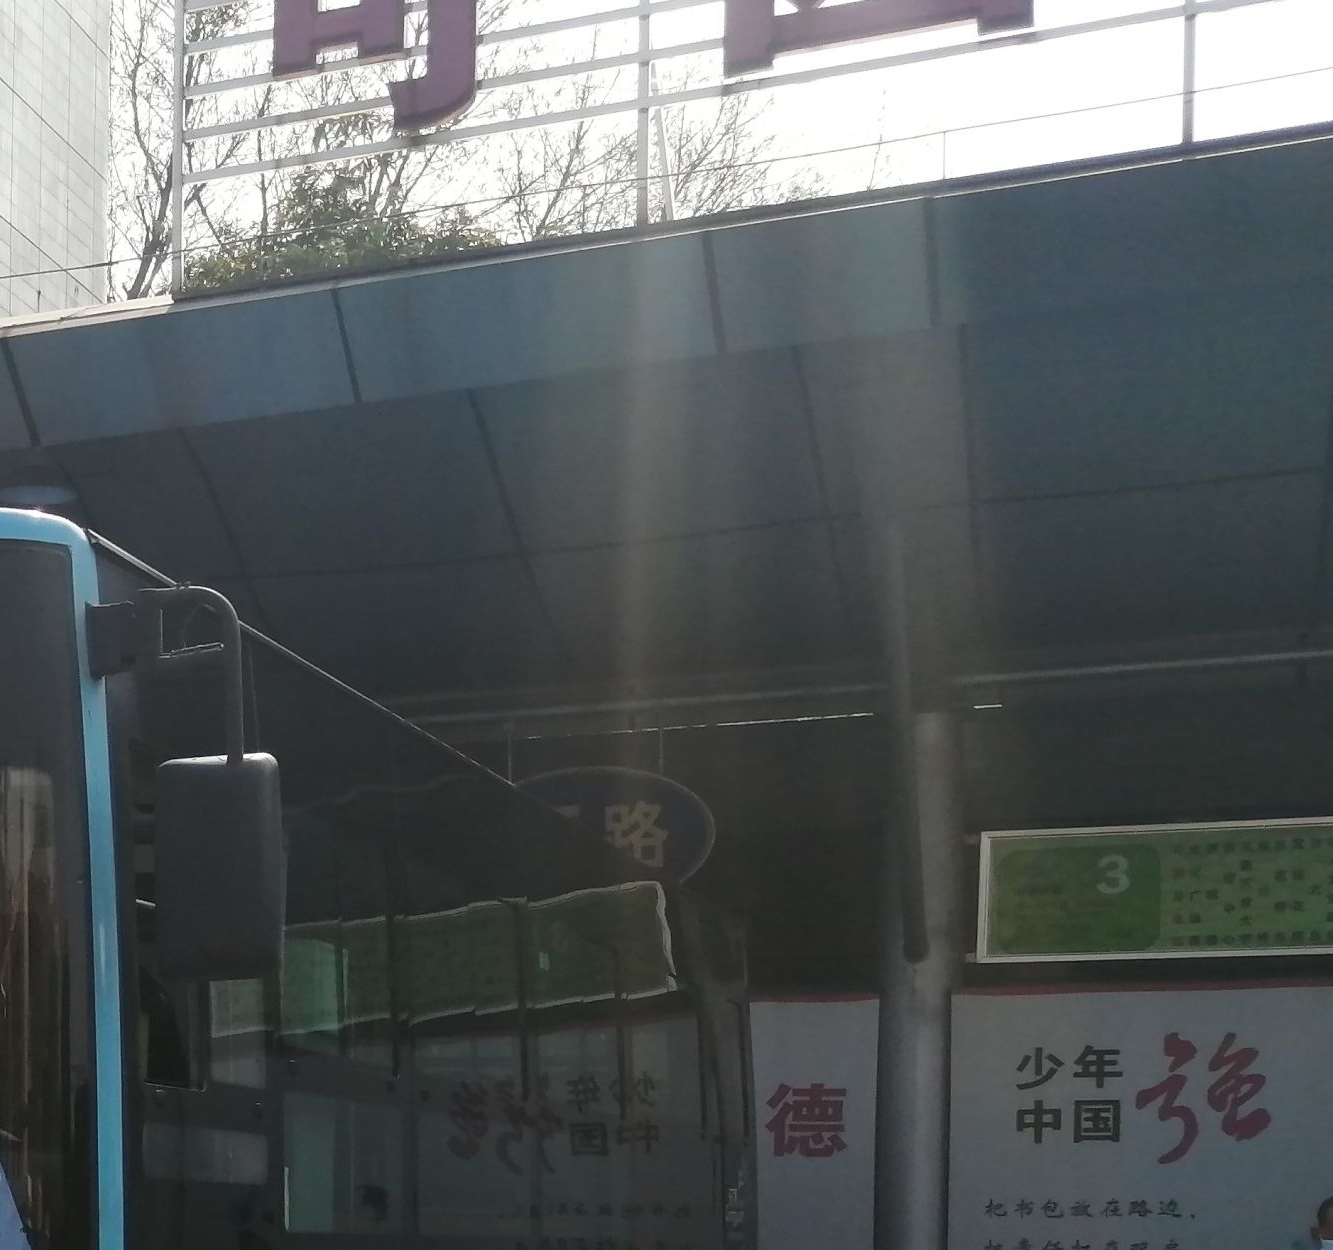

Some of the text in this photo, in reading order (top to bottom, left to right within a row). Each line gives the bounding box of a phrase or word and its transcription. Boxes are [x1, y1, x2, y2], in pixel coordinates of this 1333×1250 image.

[604, 800, 668, 869] 路
[1096, 854, 1130, 895] 3
[1015, 1044, 1124, 1091] 少年
[765, 1081, 848, 1158] 德
[1015, 1099, 1122, 1145] 中国
